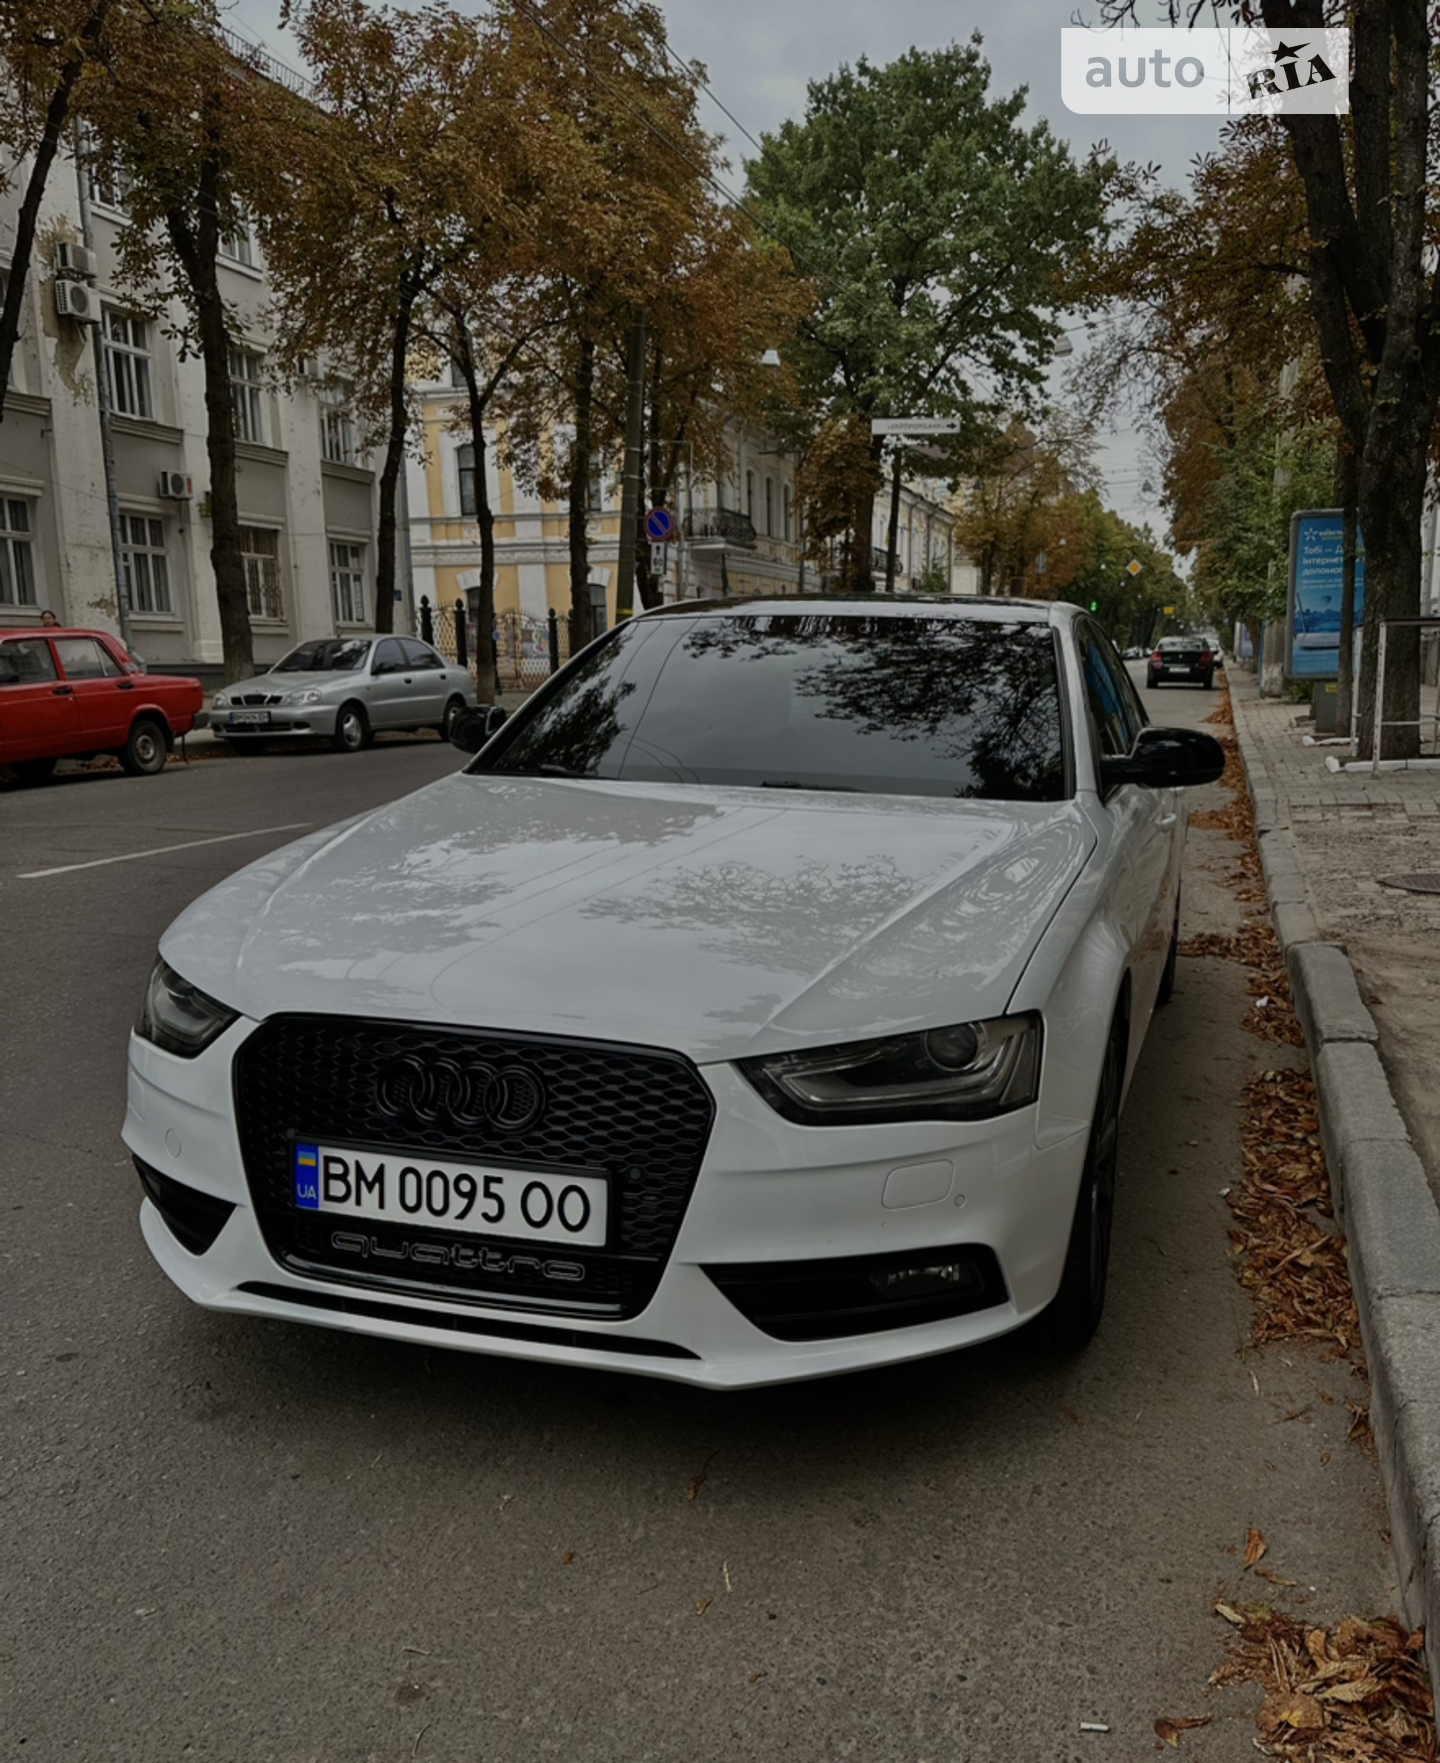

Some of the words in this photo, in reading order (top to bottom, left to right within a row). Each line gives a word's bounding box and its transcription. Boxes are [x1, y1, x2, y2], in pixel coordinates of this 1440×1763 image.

[297, 1184, 317, 1200] UA
[323, 1155, 385, 1210] BM
[399, 1166, 505, 1224] 0095
[331, 1231, 585, 1281] quattro
